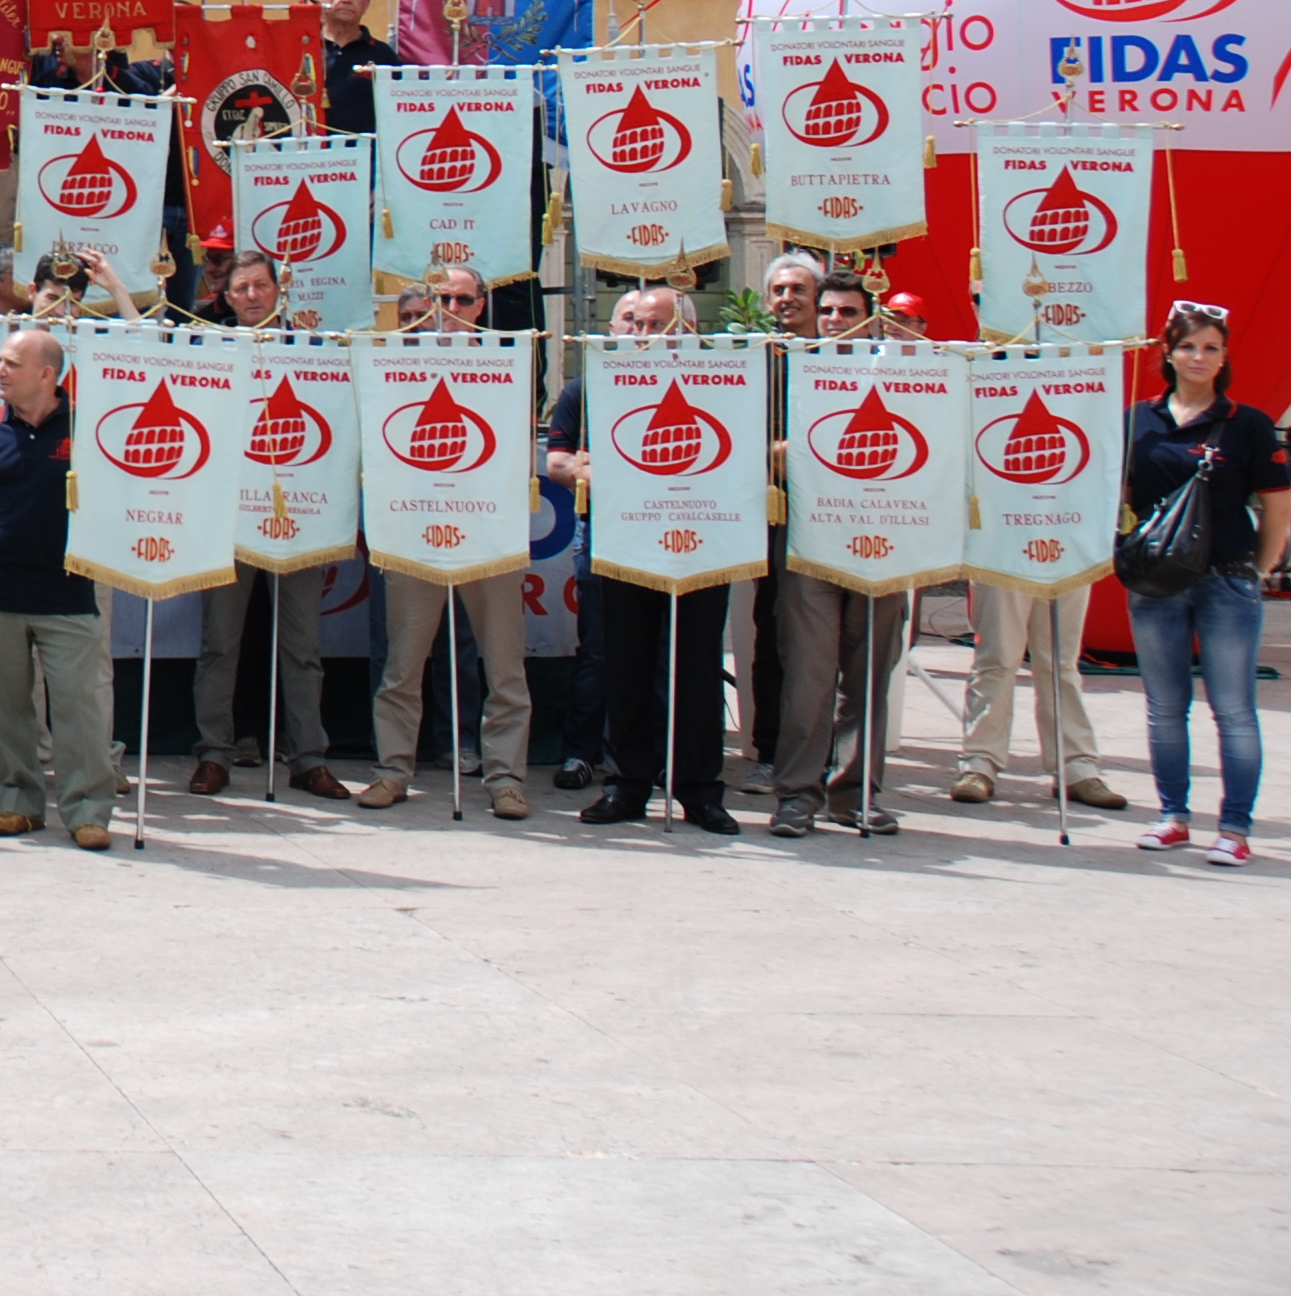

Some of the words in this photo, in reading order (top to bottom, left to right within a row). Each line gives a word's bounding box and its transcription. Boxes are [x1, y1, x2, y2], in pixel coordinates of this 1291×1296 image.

[55, 2, 147, 20] VERONA
[782, 55, 822, 66] FIDAS
[844, 53, 904, 64] VERONA
[1050, 33, 1249, 84] FIDAS
[1052, 88, 1246, 113] VERONA
[792, 174, 890, 186] BUTTAPIETRA
[612, 201, 677, 214] LAVAGNO
[429, 219, 457, 229] CAD
[464, 219, 475, 229] IT
[102, 368, 147, 383] FIDAS
[170, 374, 231, 390] VERONA
[385, 372, 427, 382] FIDAS
[451, 372, 513, 383] VERONA
[614, 374, 658, 386] FIDAS
[681, 374, 746, 385] VERONA
[814, 379, 858, 392] FIDAS
[883, 382, 947, 394] VERONA
[974, 385, 1018, 398] FIDAS
[1042, 382, 1105, 395] VERONA
[390, 500, 496, 513] CASTELNUOVO
[643, 500, 717, 510] CASTELNUOVO
[816, 498, 855, 509] BADIA
[860, 499, 927, 510] CALAVENA
[127, 509, 182, 524] NEGRAR
[621, 512, 661, 522] GRUPPO
[668, 512, 741, 522] CAVALCASELLE
[809, 514, 841, 524] ALTA
[849, 514, 874, 525] VAL
[1003, 512, 1081, 525] TREGNAGO
